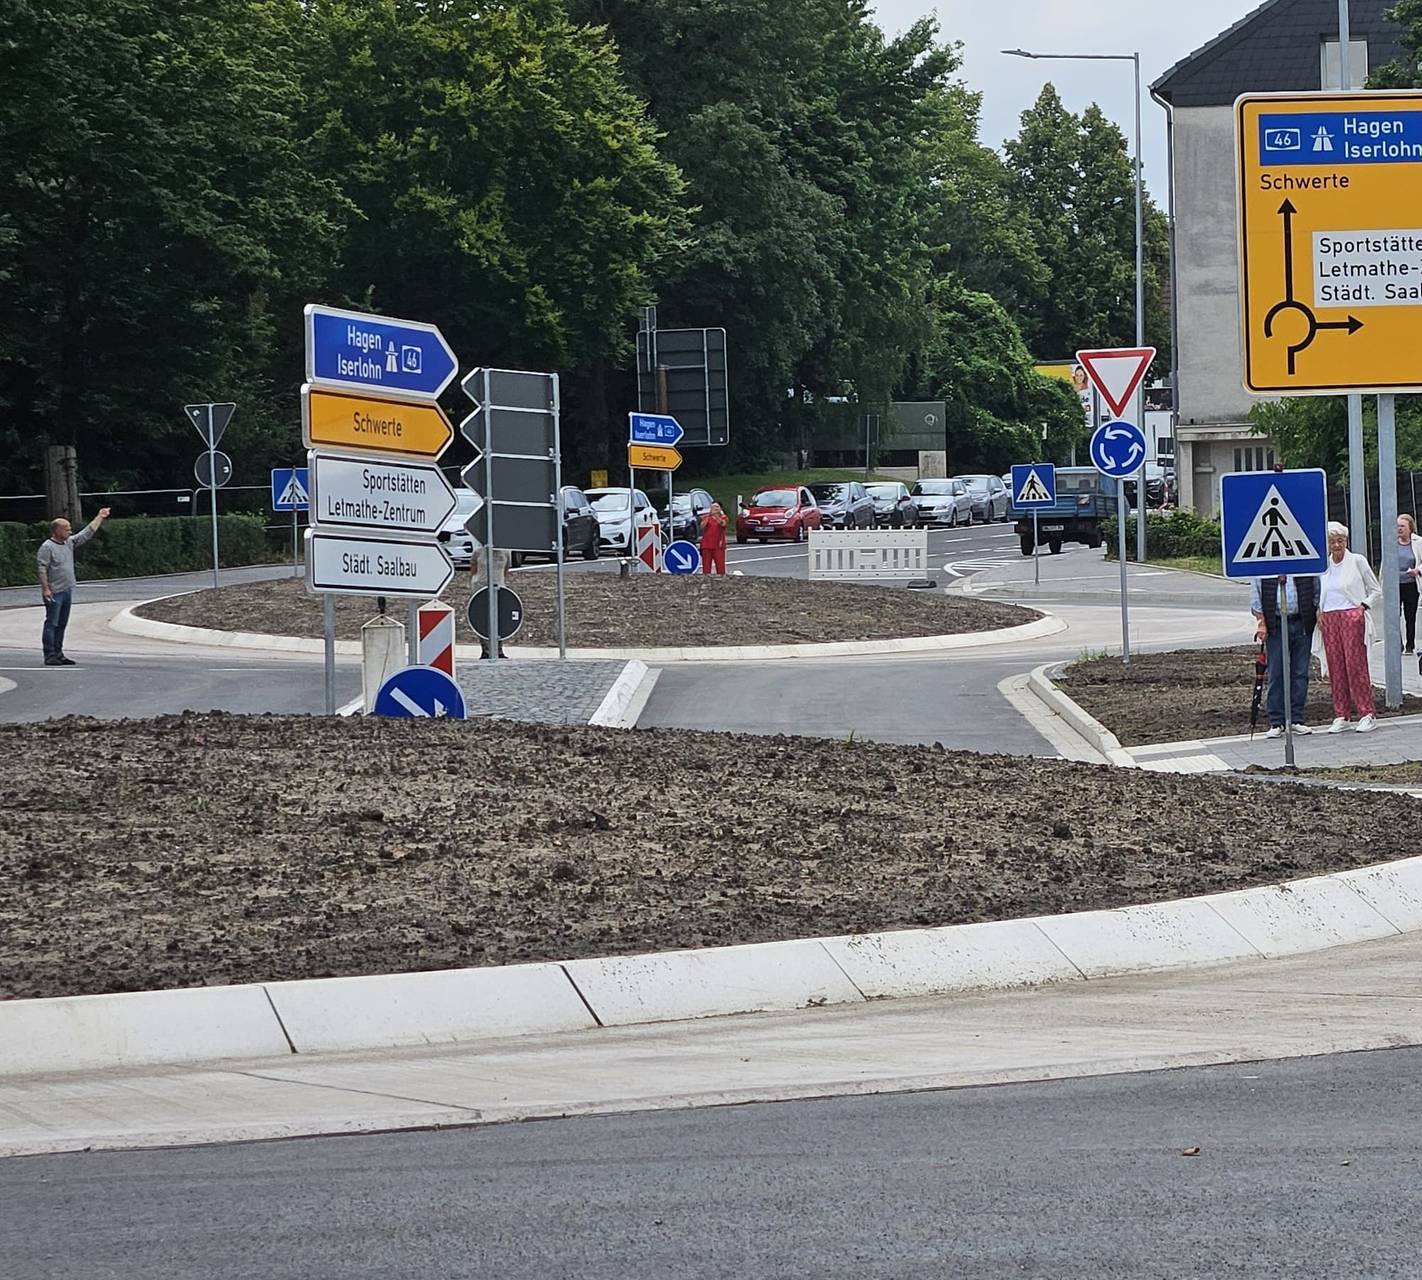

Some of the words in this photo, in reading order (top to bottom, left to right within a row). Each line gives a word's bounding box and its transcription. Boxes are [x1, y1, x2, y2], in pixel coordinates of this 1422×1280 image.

[1274, 133, 1292, 147] 46
[1344, 117, 1403, 138] Hagen
[1344, 141, 1422, 158] Iserlohn
[1260, 173, 1350, 190] Schwerte
[1321, 284, 1375, 301] Städt.
[347, 325, 382, 353] Hagen
[337, 353, 382, 380] Iserlohn
[406, 351, 417, 368] 46
[353, 411, 402, 437] Schwerte
[362, 468, 426, 494] Sportstätten
[328, 495, 426, 524] Letmathe-Zentrum
[342, 552, 373, 575] Städt.
[377, 555, 417, 577] Saalbau
